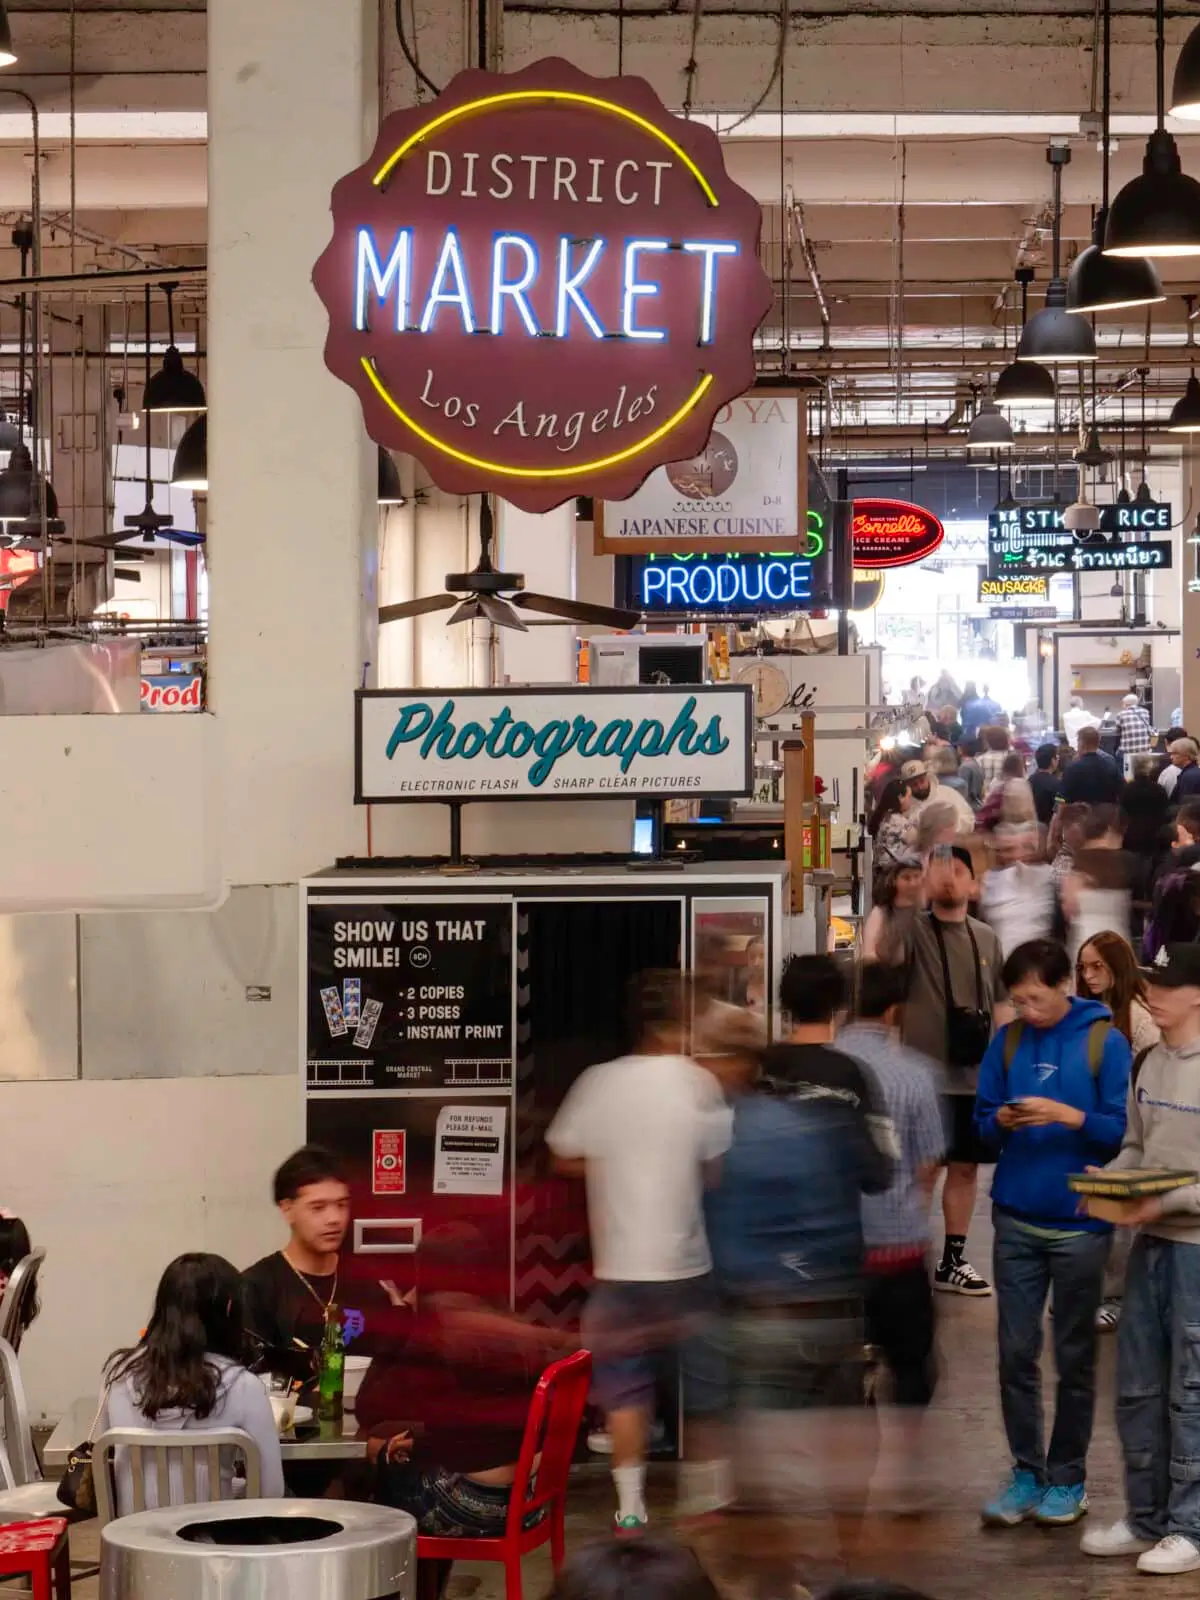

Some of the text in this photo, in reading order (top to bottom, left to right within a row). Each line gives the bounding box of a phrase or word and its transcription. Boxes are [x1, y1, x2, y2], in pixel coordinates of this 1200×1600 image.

[425, 149, 673, 206] DISTRICT
[354, 228, 740, 345] MARKET
[419, 369, 659, 452] Los Angeles
[618, 517, 786, 537] JAPANESE CUISINE
[1118, 508, 1169, 527] RICE
[642, 562, 813, 605] PRODUCE
[384, 696, 730, 788] Photographs
[400, 775, 702, 792] ELECTRONIC FLASH SHARP CLEAR PICTURES
[333, 920, 486, 942] SHOW US THAT
[333, 947, 400, 968] SMILE!
[407, 985, 465, 1000] 2 COPIES
[407, 1006, 461, 1019] 3 POSES
[407, 1025, 504, 1039] INSTANT PRINT
[464, 1115, 493, 1123] REFUNDS
